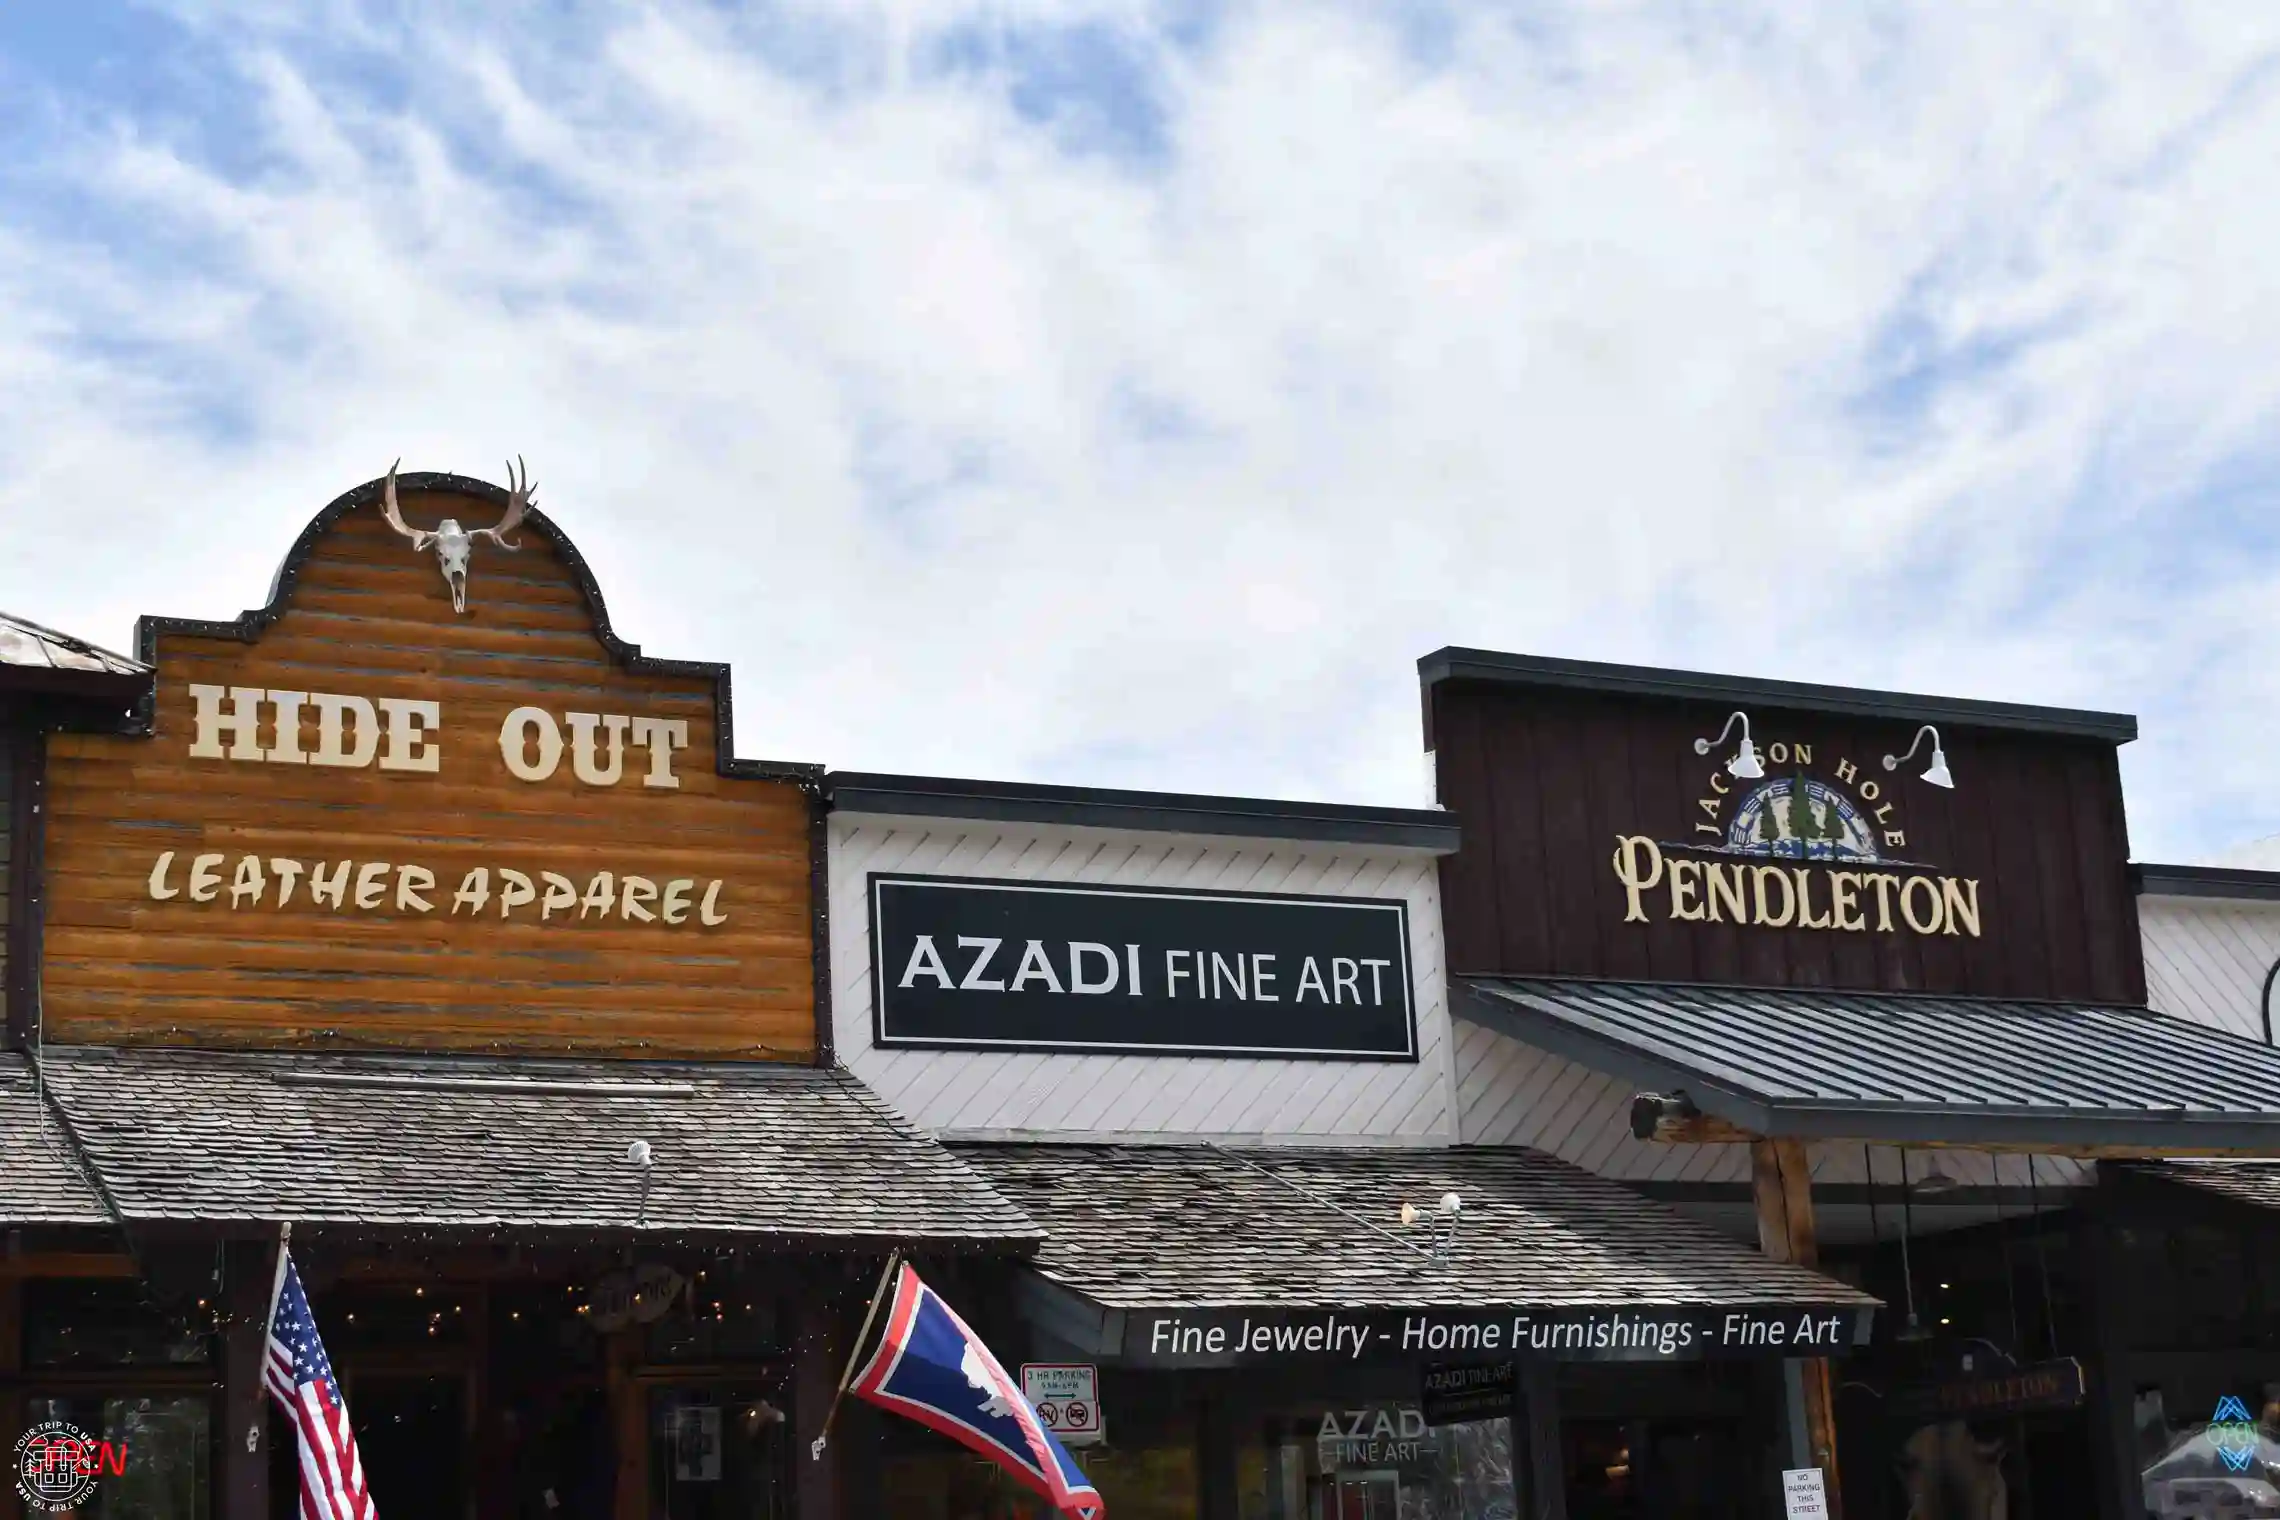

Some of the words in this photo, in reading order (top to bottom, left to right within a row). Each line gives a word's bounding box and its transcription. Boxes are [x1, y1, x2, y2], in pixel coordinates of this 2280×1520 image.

[189, 684, 440, 773] HIDE
[498, 706, 688, 788] OUT
[1834, 757, 1905, 848] HOLE
[148, 852, 436, 912] LEATHER
[451, 867, 729, 927] APPAREL
[1613, 835, 1982, 938] PENDLETON
[898, 934, 1142, 997] AZADI
[1165, 949, 1280, 1002] FINE
[1295, 956, 1391, 1006] ART
[1151, 1319, 1226, 1354] Fine
[1235, 1316, 1369, 1358] Jewelry
[1402, 1317, 1501, 1350] Home
[1511, 1314, 1692, 1354] Furnishings
[1722, 1314, 1785, 1345] Fine
[1793, 1313, 1841, 1344] Art
[1037, 1371, 1049, 1381] HR
[1053, 1370, 1091, 1381] PARKING
[1425, 1369, 1466, 1390] AZADI
[2206, 1421, 2260, 1446] OPEN
[1336, 1441, 1379, 1464] FINE
[1384, 1441, 1421, 1462] ART
[1788, 1483, 1820, 1492] PARKING
[1797, 1473, 1807, 1481] NO
[1793, 1505, 1820, 1513] STREET
[1797, 1494, 1813, 1502] THIS
